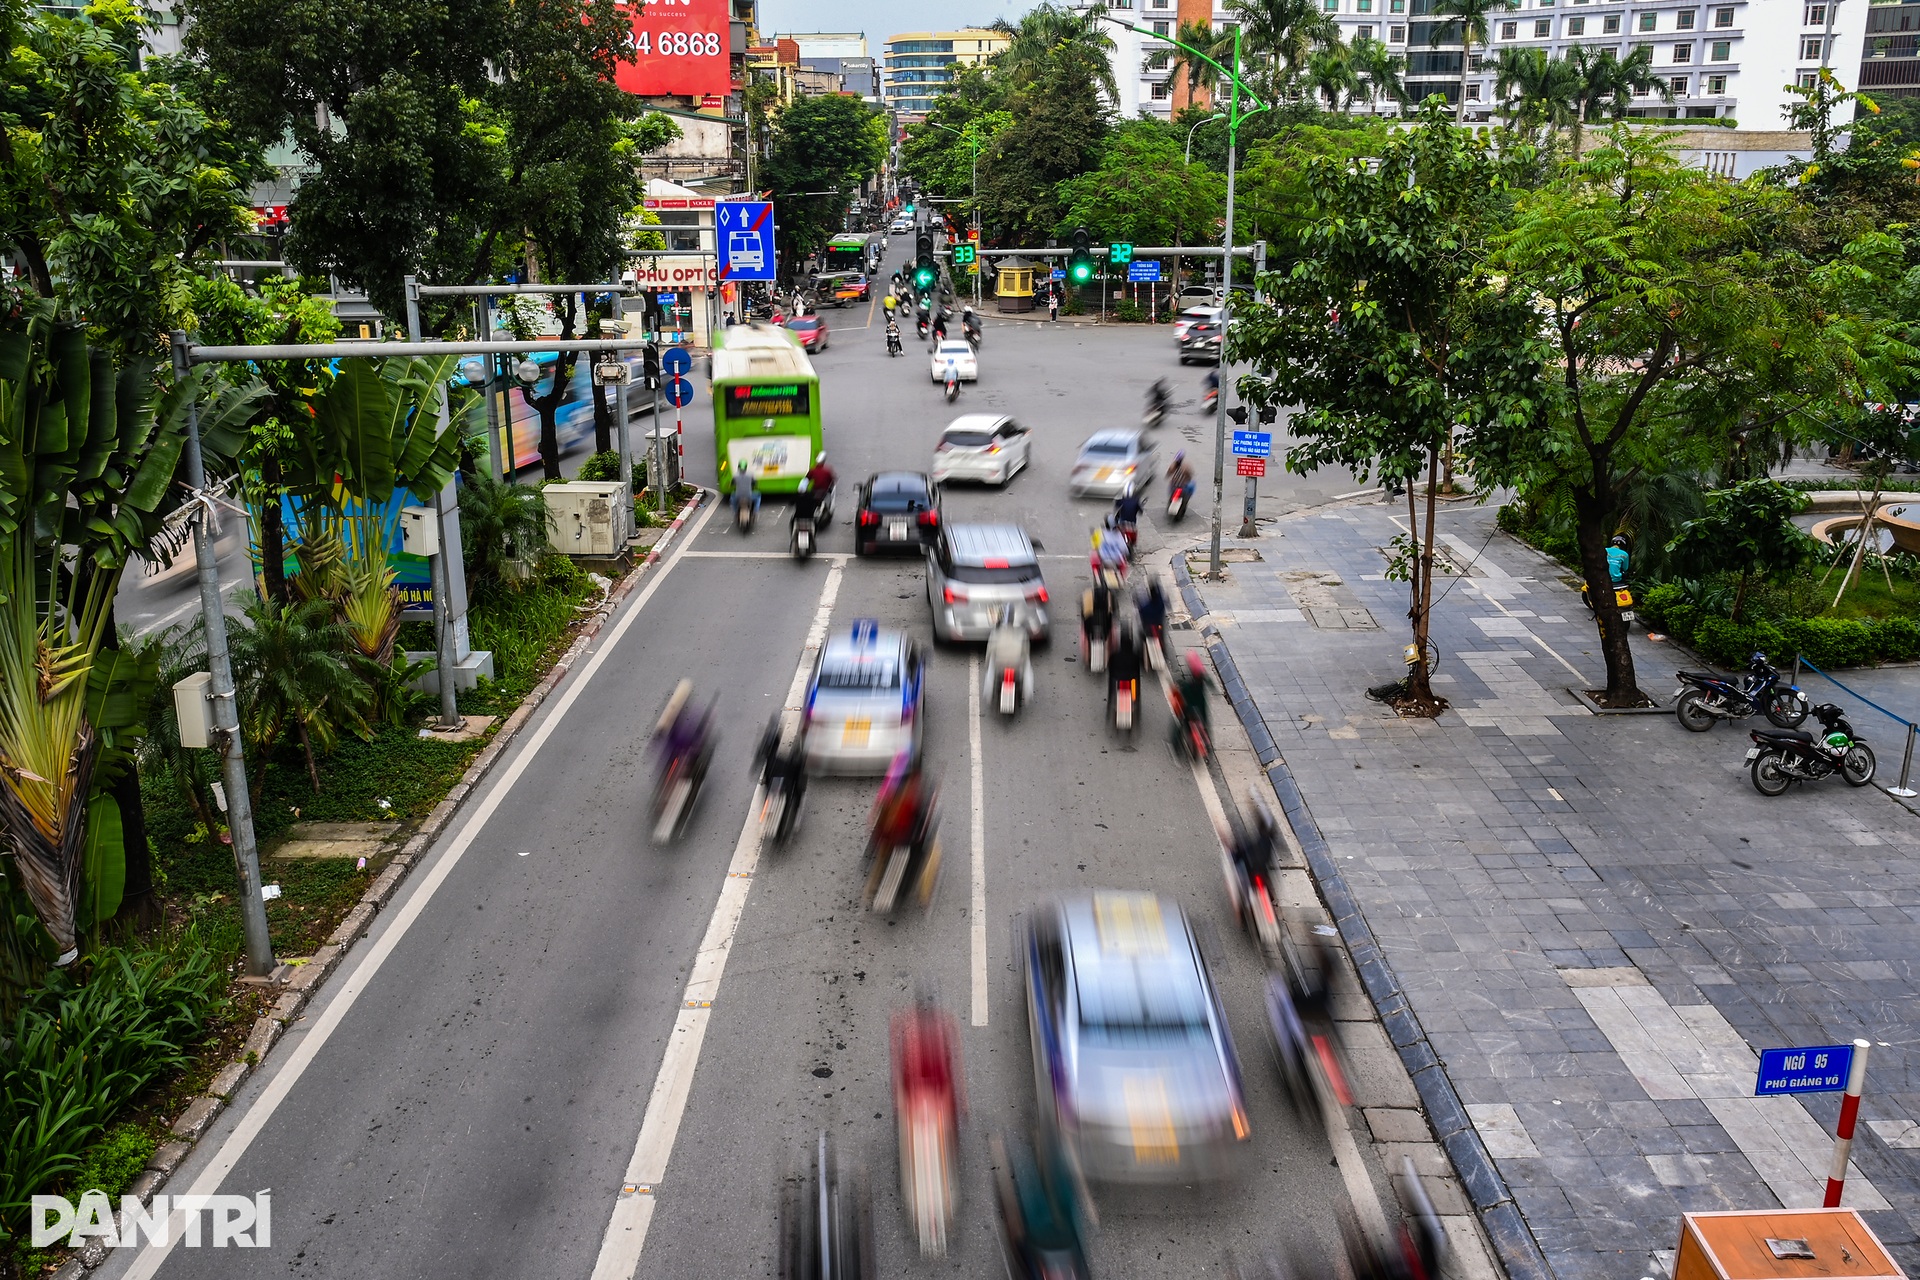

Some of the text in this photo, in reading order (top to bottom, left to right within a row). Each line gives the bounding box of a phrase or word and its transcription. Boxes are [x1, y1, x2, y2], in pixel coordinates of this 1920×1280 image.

[658, 32, 721, 56] 6868
[955, 246, 974, 263] 33
[1111, 243, 1132, 263] 32
[410, 588, 422, 602] HÀ
[1783, 1052, 1829, 1071] NGÕ 95
[1765, 1074, 1839, 1089] PHỐ GIẢNG VÕ
